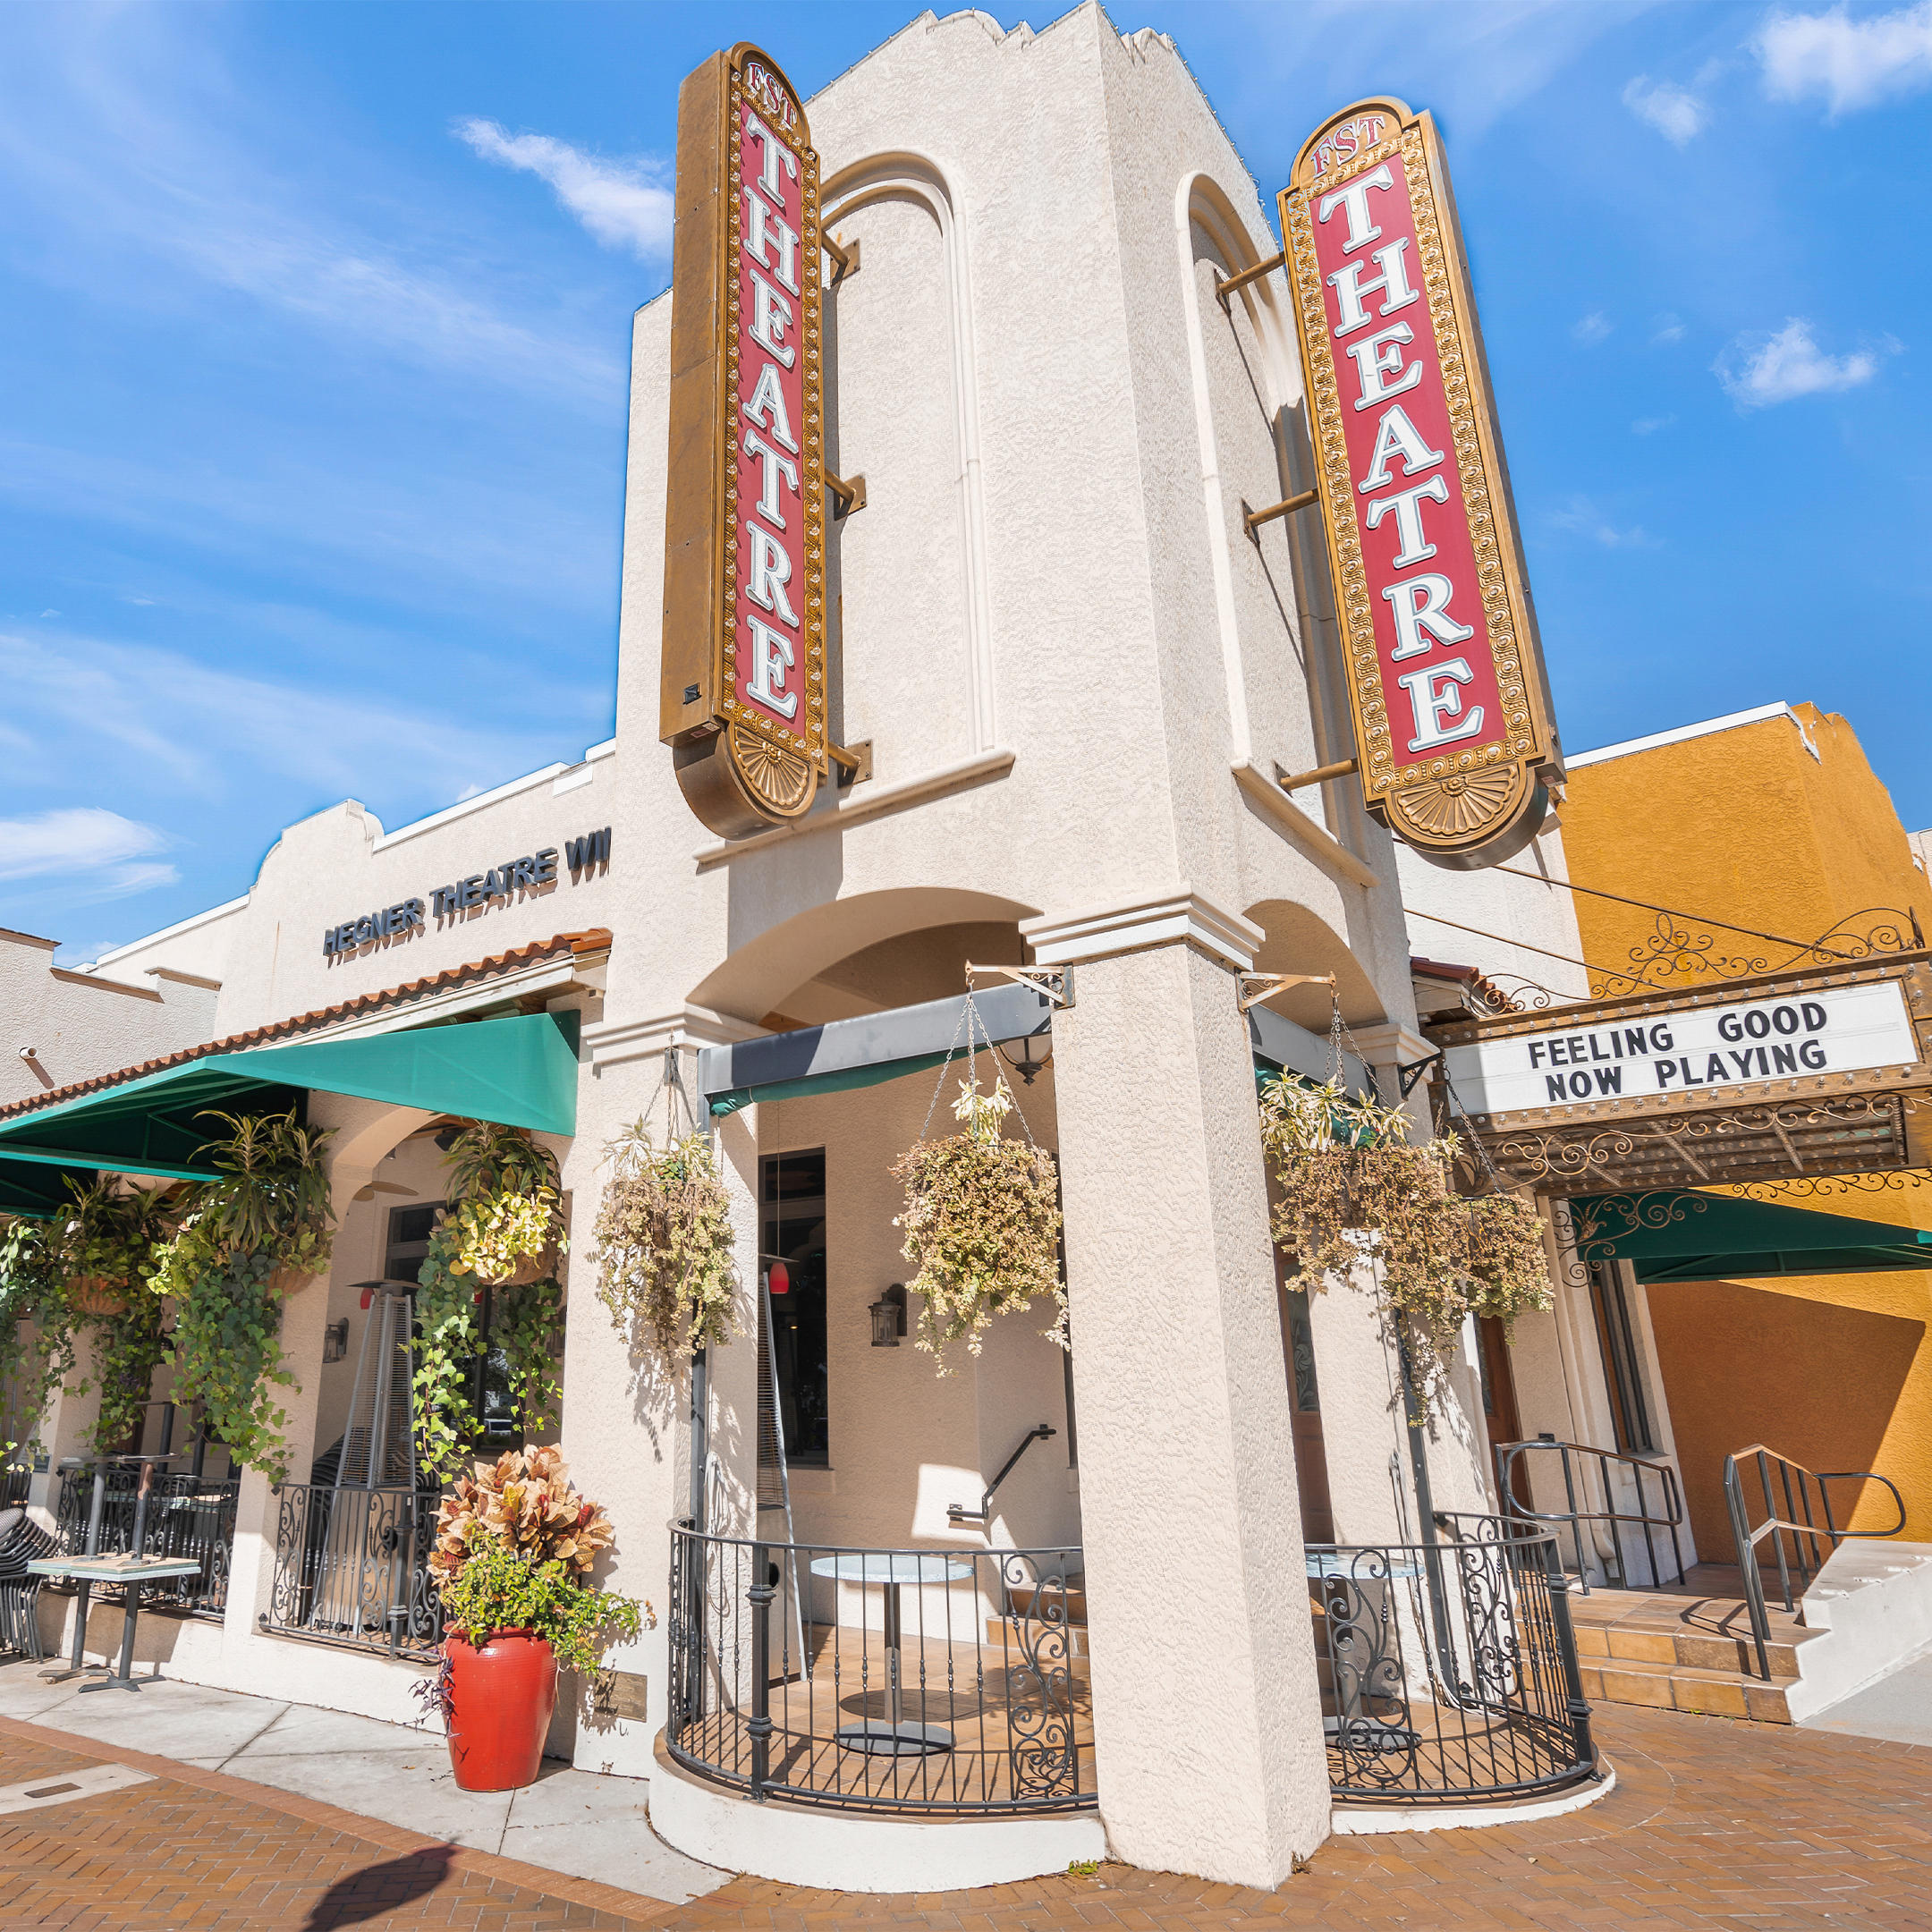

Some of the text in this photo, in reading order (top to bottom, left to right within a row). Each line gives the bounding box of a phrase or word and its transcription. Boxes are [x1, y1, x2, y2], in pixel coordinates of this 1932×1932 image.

[747, 62, 797, 131] FST
[1310, 115, 1385, 179] FST
[742, 112, 801, 718] THEATRE
[1318, 164, 1485, 753] THEATRE
[323, 896, 426, 957] HEGNER
[428, 846, 559, 919] THEATRE
[1528, 1002, 1827, 1069] FEELING GOOD
[1545, 1039, 1827, 1102] NOW PLAYING
